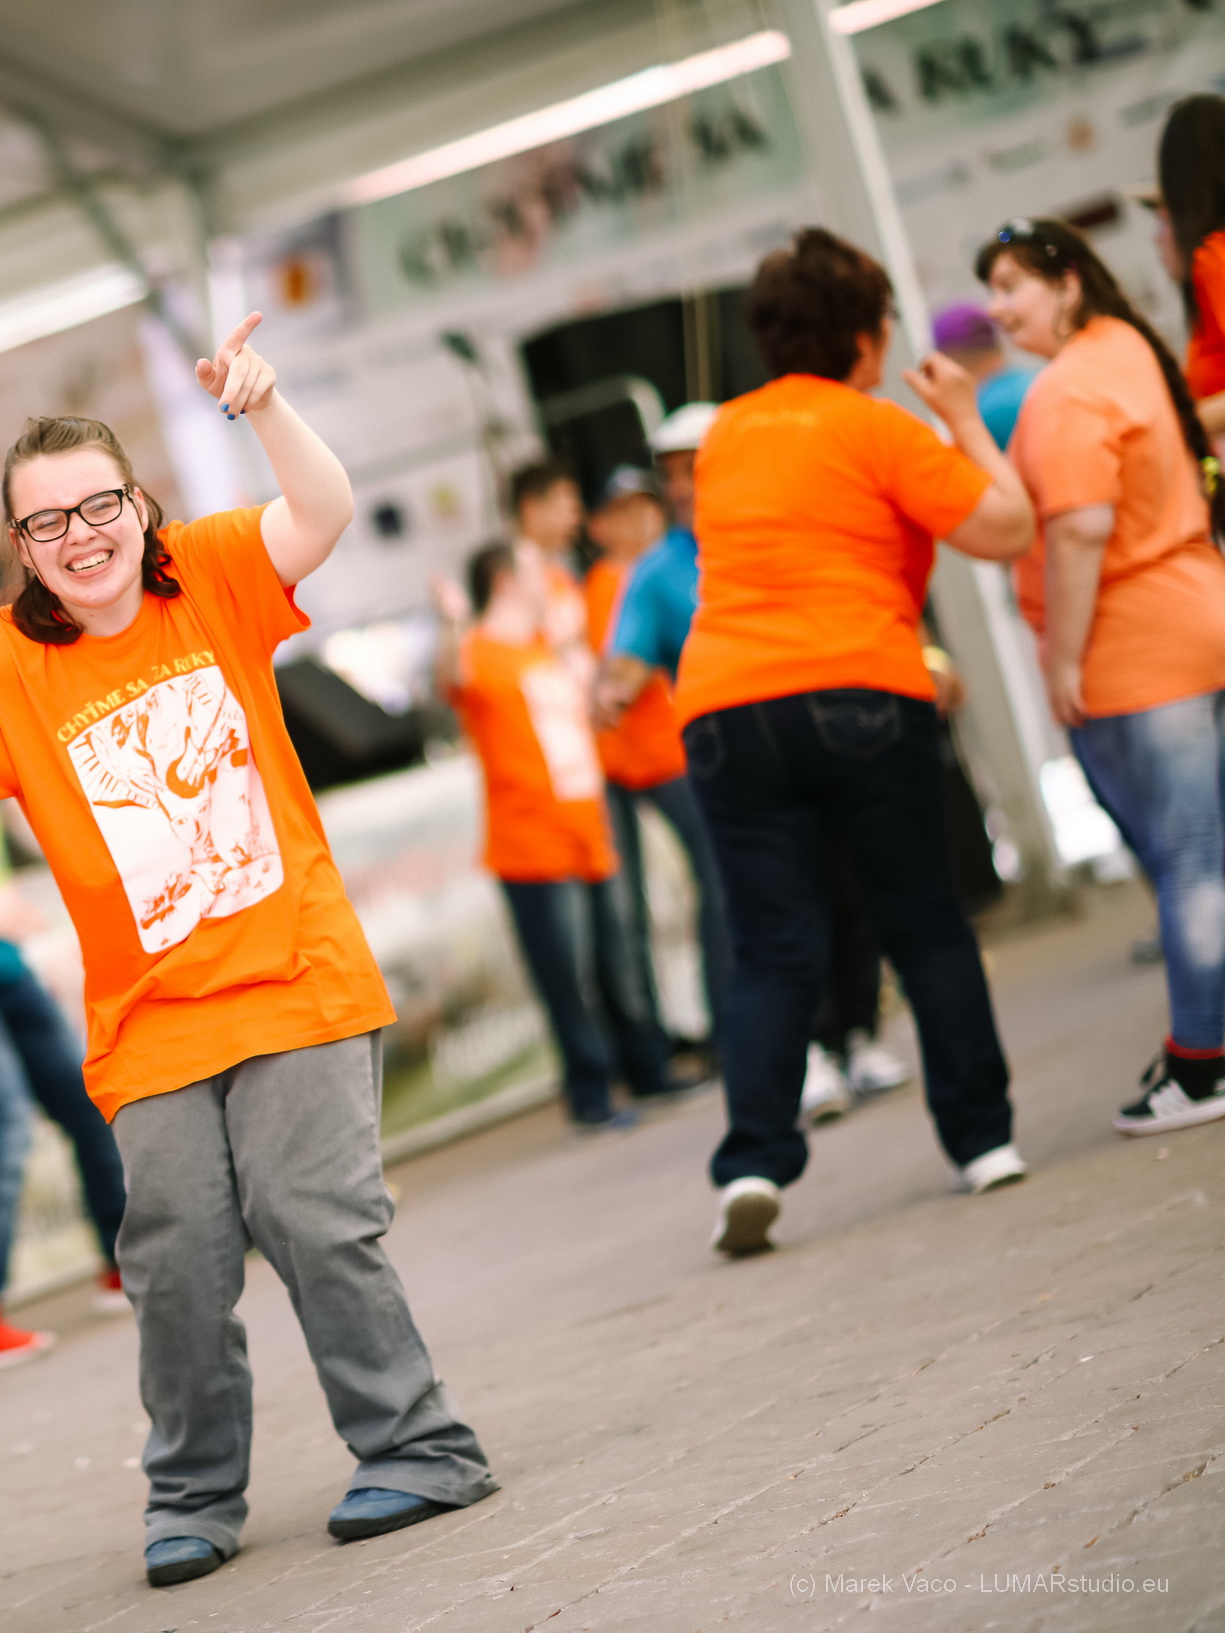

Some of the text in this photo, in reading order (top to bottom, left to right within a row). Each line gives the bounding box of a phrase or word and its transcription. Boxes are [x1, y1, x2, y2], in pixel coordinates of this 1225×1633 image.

[57, 650, 216, 742] CHYŤME SA ZA RUKY
